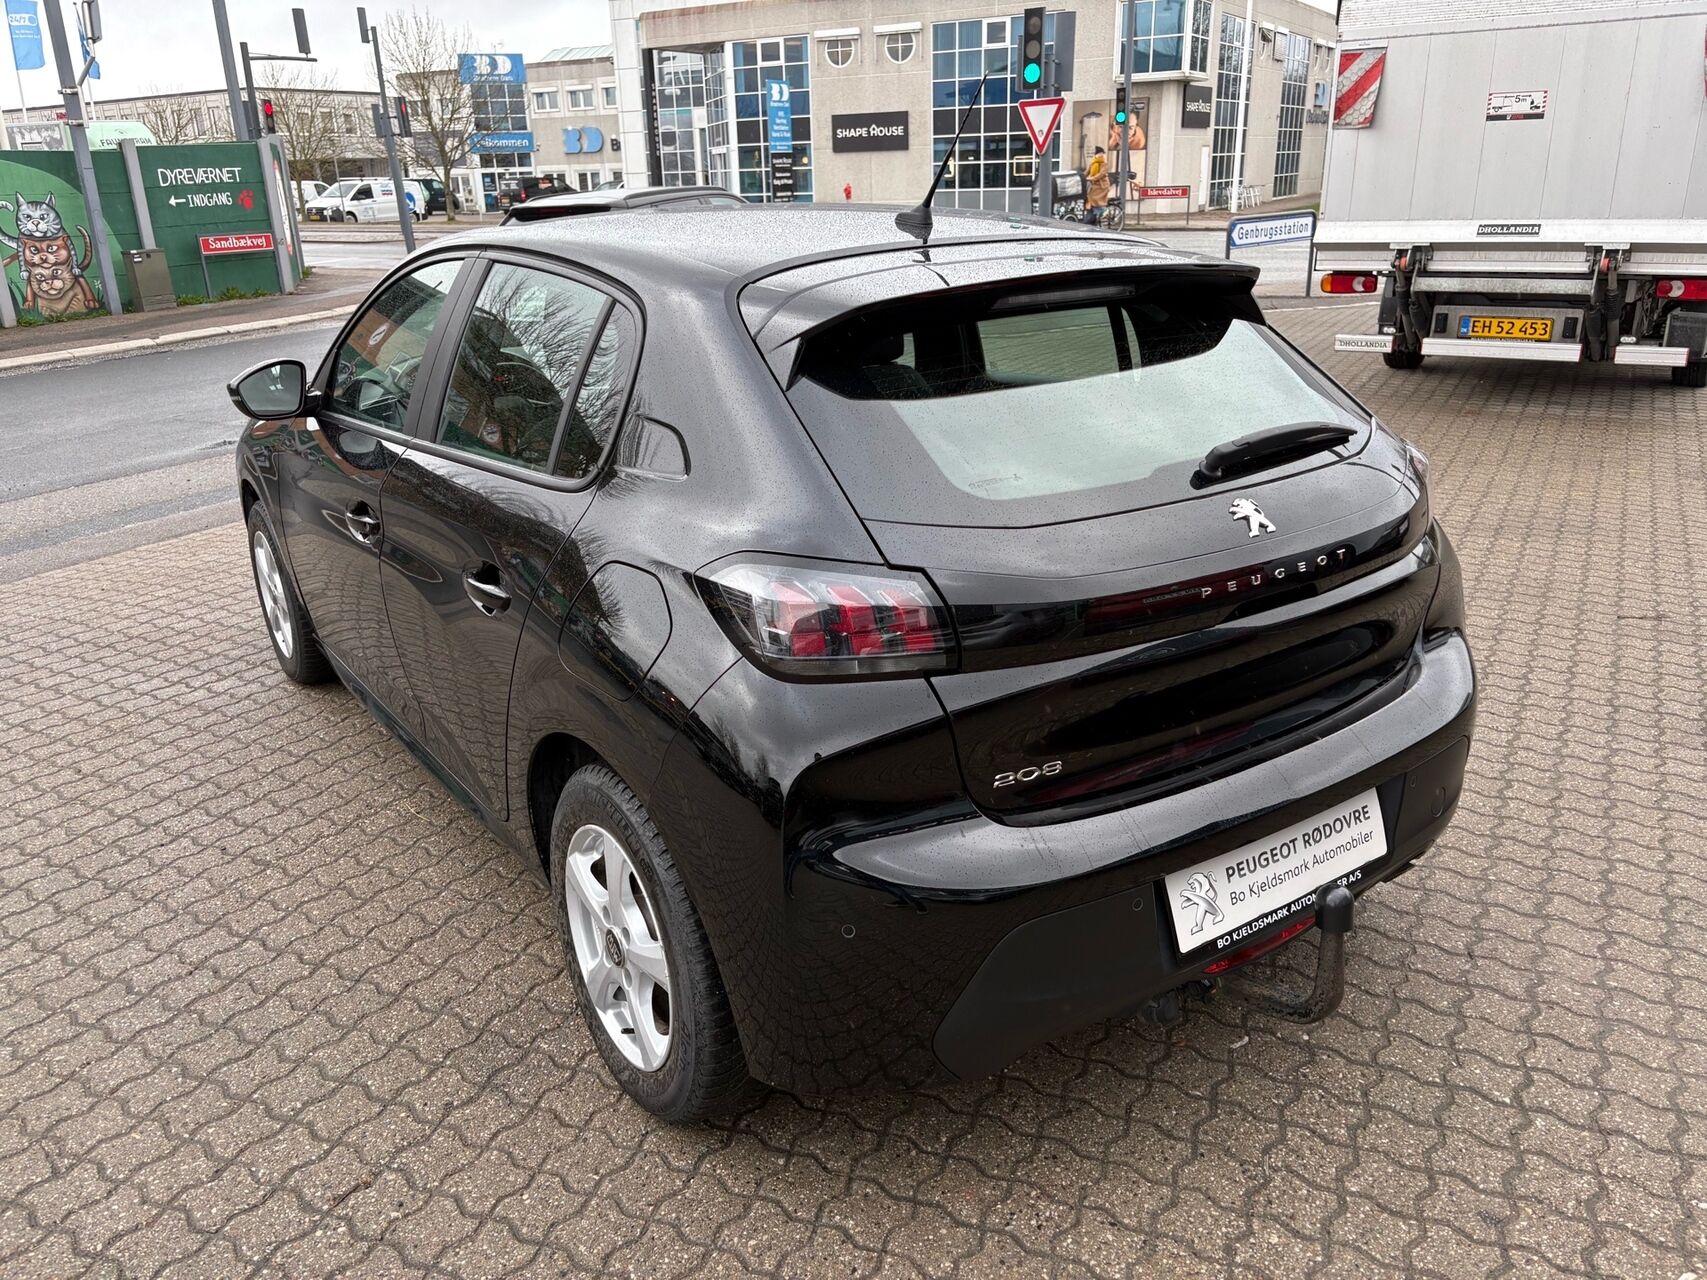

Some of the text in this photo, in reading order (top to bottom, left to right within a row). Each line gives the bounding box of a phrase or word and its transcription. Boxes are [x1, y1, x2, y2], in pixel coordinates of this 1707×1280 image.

[836, 124, 905, 138] SHAPE HOUSE
[157, 167, 242, 187] DYREVÆRNET
[187, 192, 233, 208] INDGANG
[1147, 188, 1183, 197] Islevdalvej
[1237, 221, 1309, 241] Genbrugsstation
[1477, 226, 1540, 234] DHOLLANDIA
[208, 236, 267, 249] Sandbækvej
[1471, 320, 1549, 337] EH 52 453
[1339, 339, 1388, 349] DHOLLANDIA
[1201, 548, 1346, 599] PEUGEOT
[993, 760, 1063, 788] 208
[1225, 804, 1371, 883] PEUGEOT RØDOVRE
[1229, 830, 1374, 906] Bo Kjeldsmark Automobiler
[1216, 935, 1231, 949] BO
[1232, 906, 1291, 941] KJELDSMARK
[1348, 869, 1362, 884] A/S
